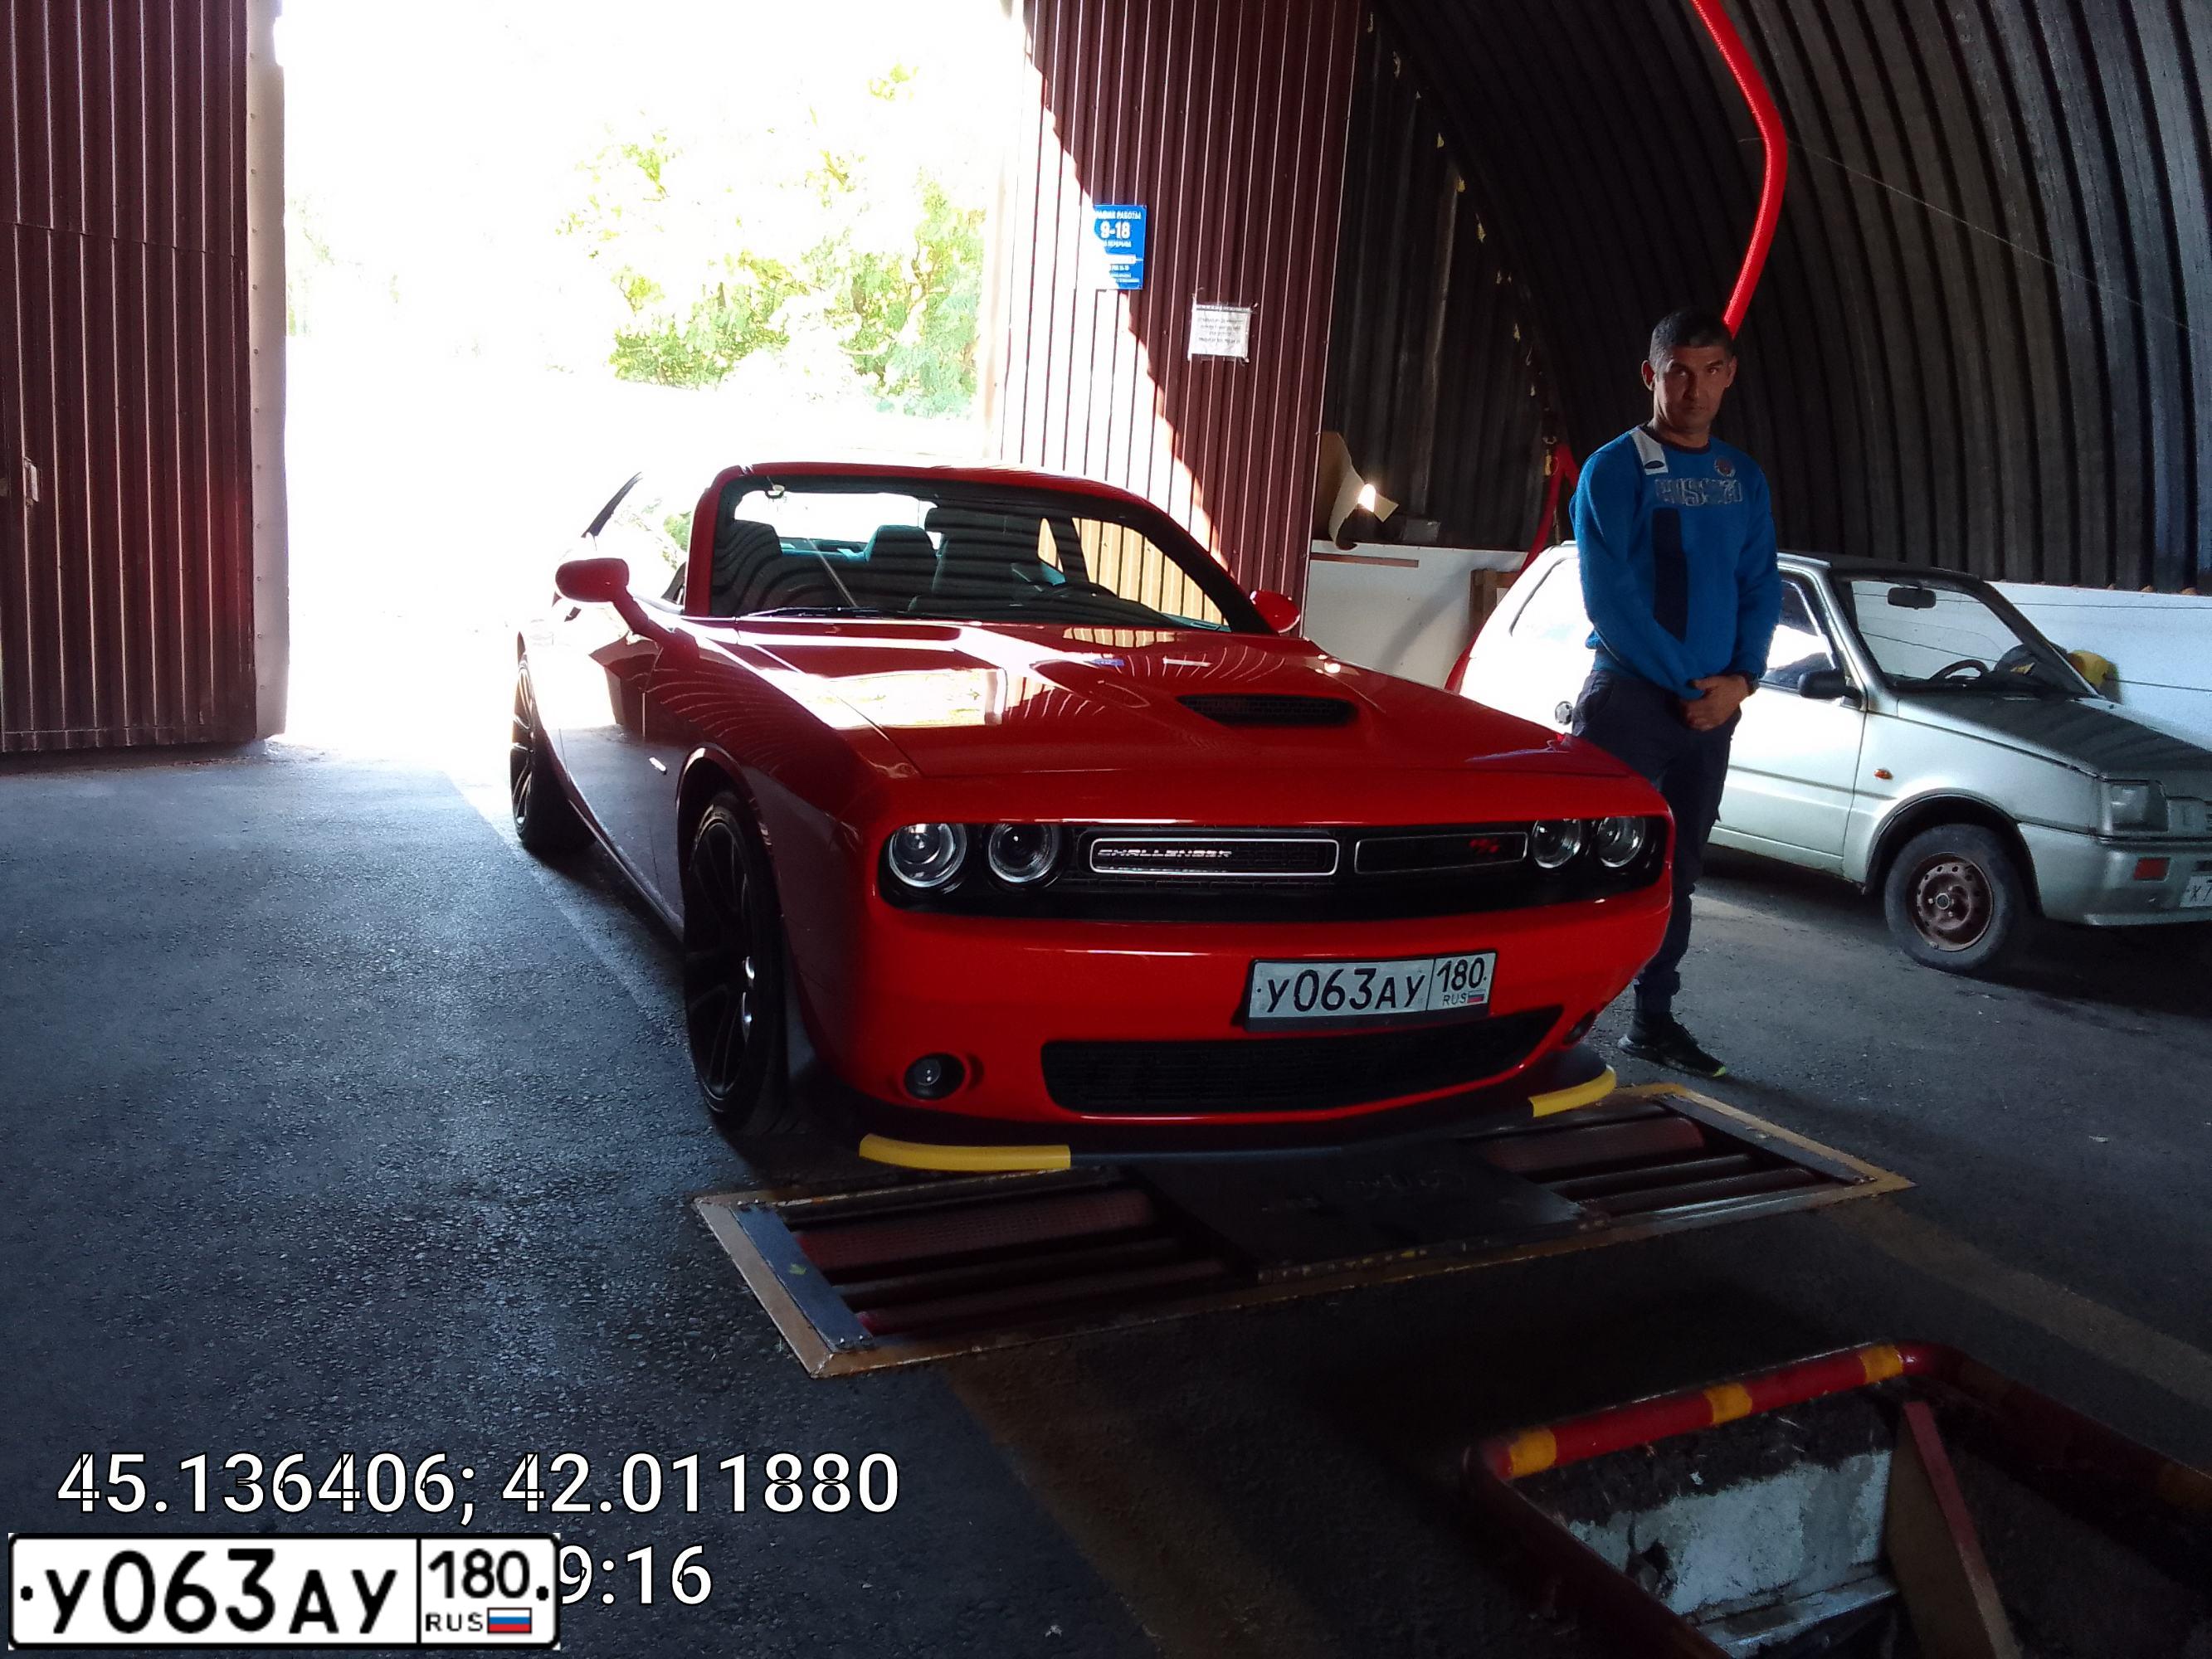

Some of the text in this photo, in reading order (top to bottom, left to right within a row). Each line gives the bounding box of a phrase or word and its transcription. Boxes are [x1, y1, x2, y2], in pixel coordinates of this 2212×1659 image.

[1117, 211, 1141, 220] РАБОТЫ
[1100, 221, 1131, 239] 9-18
[1097, 848, 1233, 859] CHALLENGER
[1267, 957, 1485, 1013] У063АУ 180
[1442, 992, 1467, 1005] RUS
